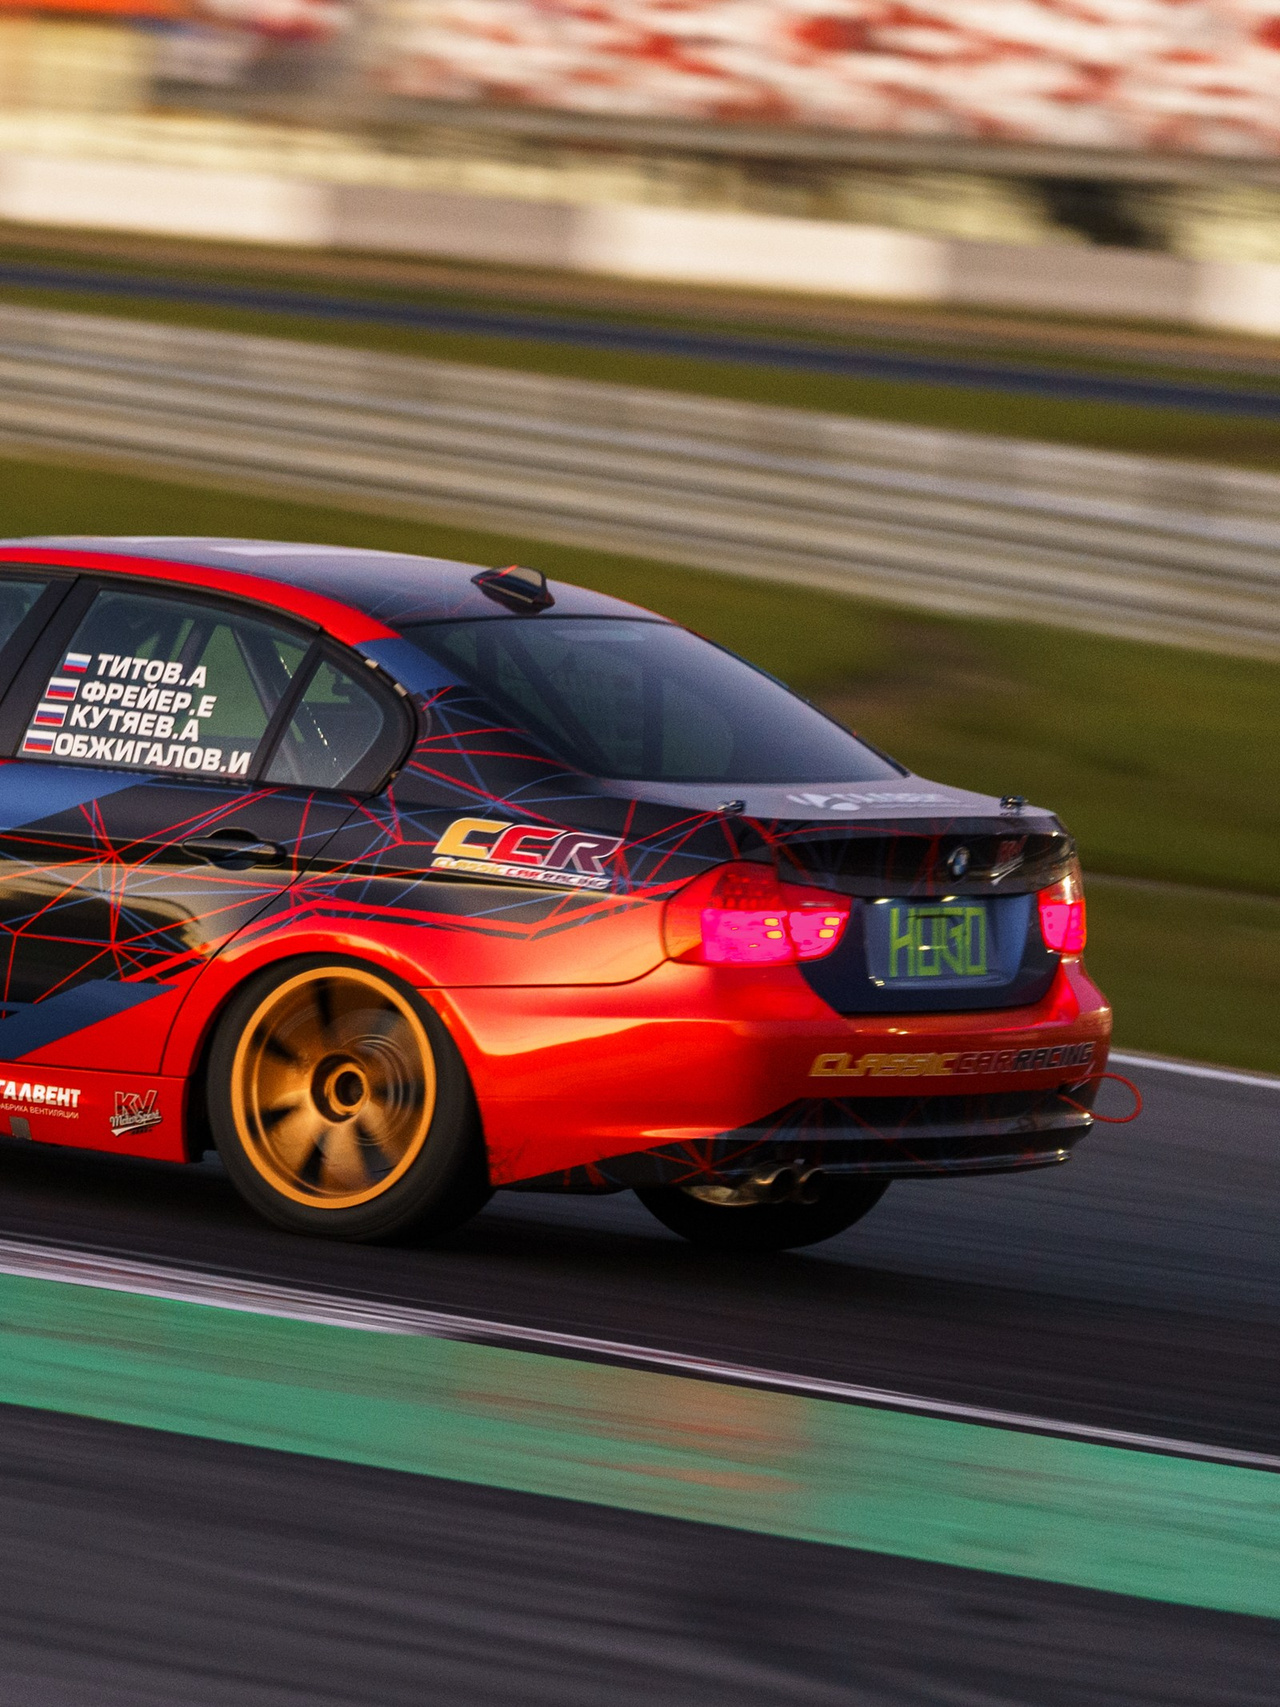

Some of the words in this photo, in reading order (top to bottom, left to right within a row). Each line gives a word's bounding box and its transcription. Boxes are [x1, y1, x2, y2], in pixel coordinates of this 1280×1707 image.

[96, 653, 207, 689] ТИТОВ.А
[80, 680, 217, 718] ФРЕЙЕР.Е
[70, 704, 199, 743] КУТЯЕВ.А
[53, 733, 251, 775] ОБЖИГАЛОВ.И
[432, 817, 625, 876] CCR
[809, 1051, 958, 1077] CLASSIC
[952, 1049, 1021, 1075] CAR
[1014, 1041, 1097, 1072] RACING
[29, 1105, 80, 1119] ВЕНТИЛЯЦИИ
